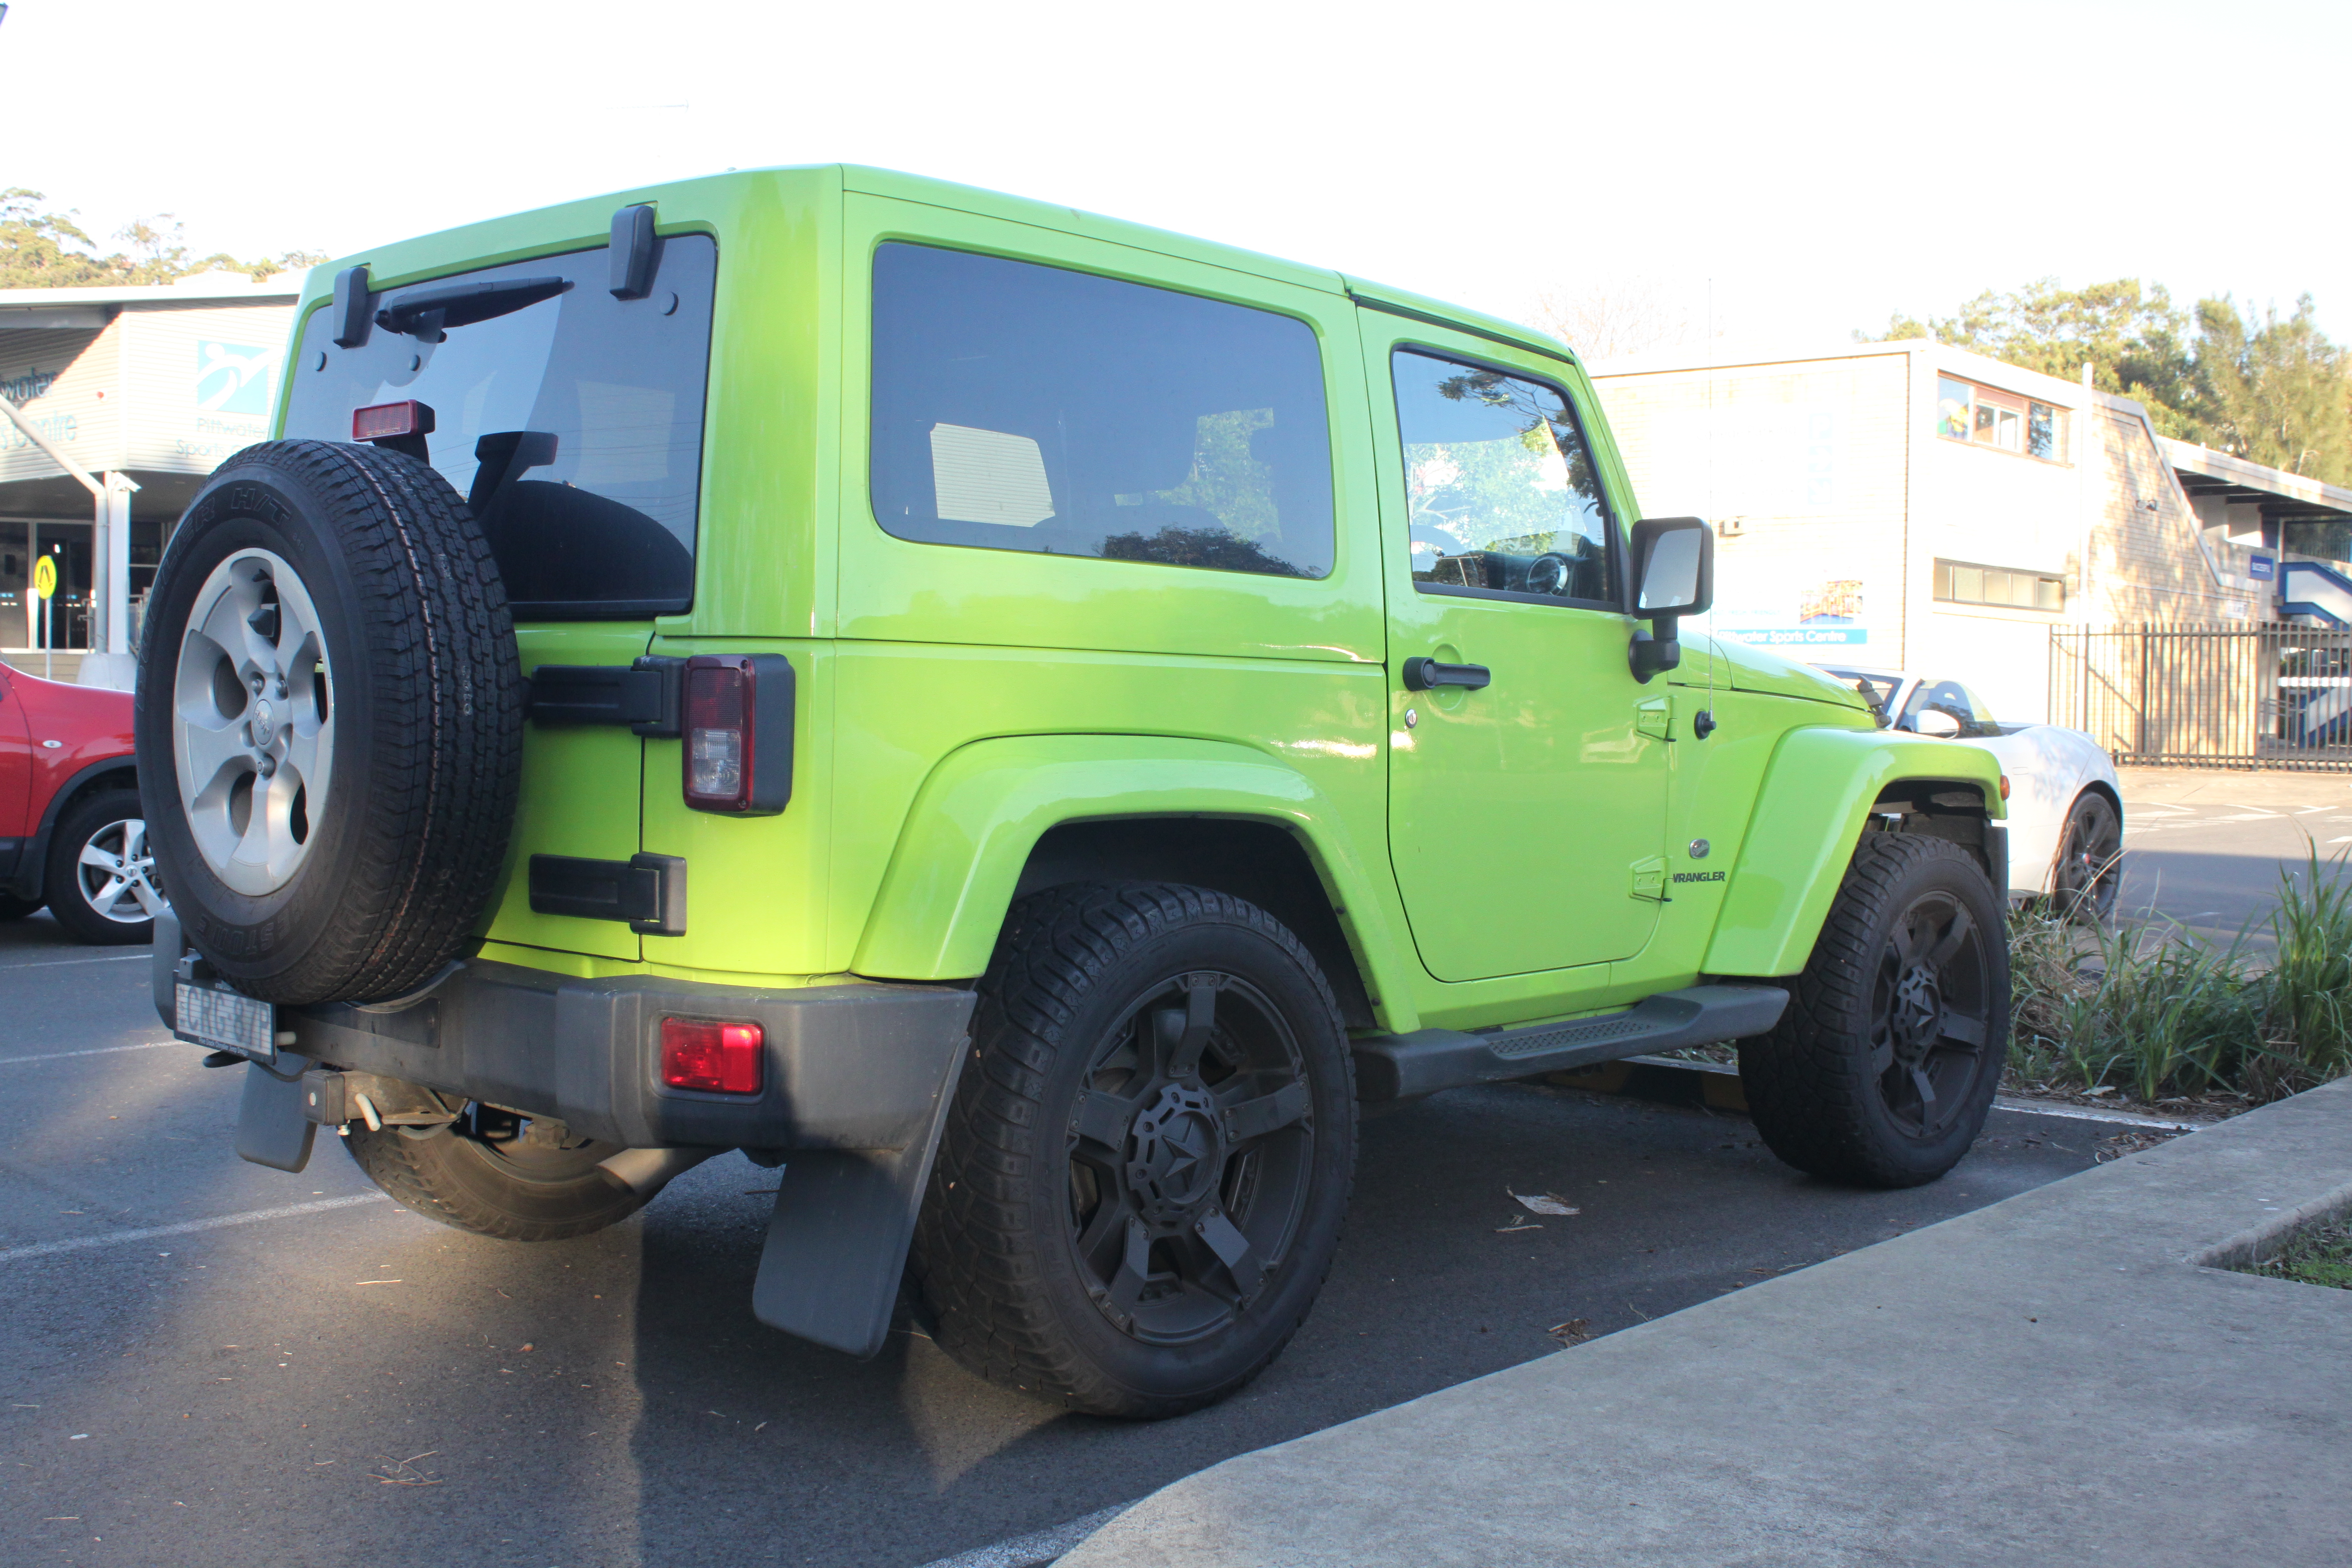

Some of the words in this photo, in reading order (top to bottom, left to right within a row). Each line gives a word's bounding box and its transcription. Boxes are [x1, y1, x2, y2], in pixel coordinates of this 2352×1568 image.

[176, 439, 226, 458] Sports
[1718, 630, 1767, 643] Pittwater
[1770, 631, 1803, 643] Sports
[1807, 630, 1846, 641] Centre
[1673, 871, 1725, 882] WRANGLER
